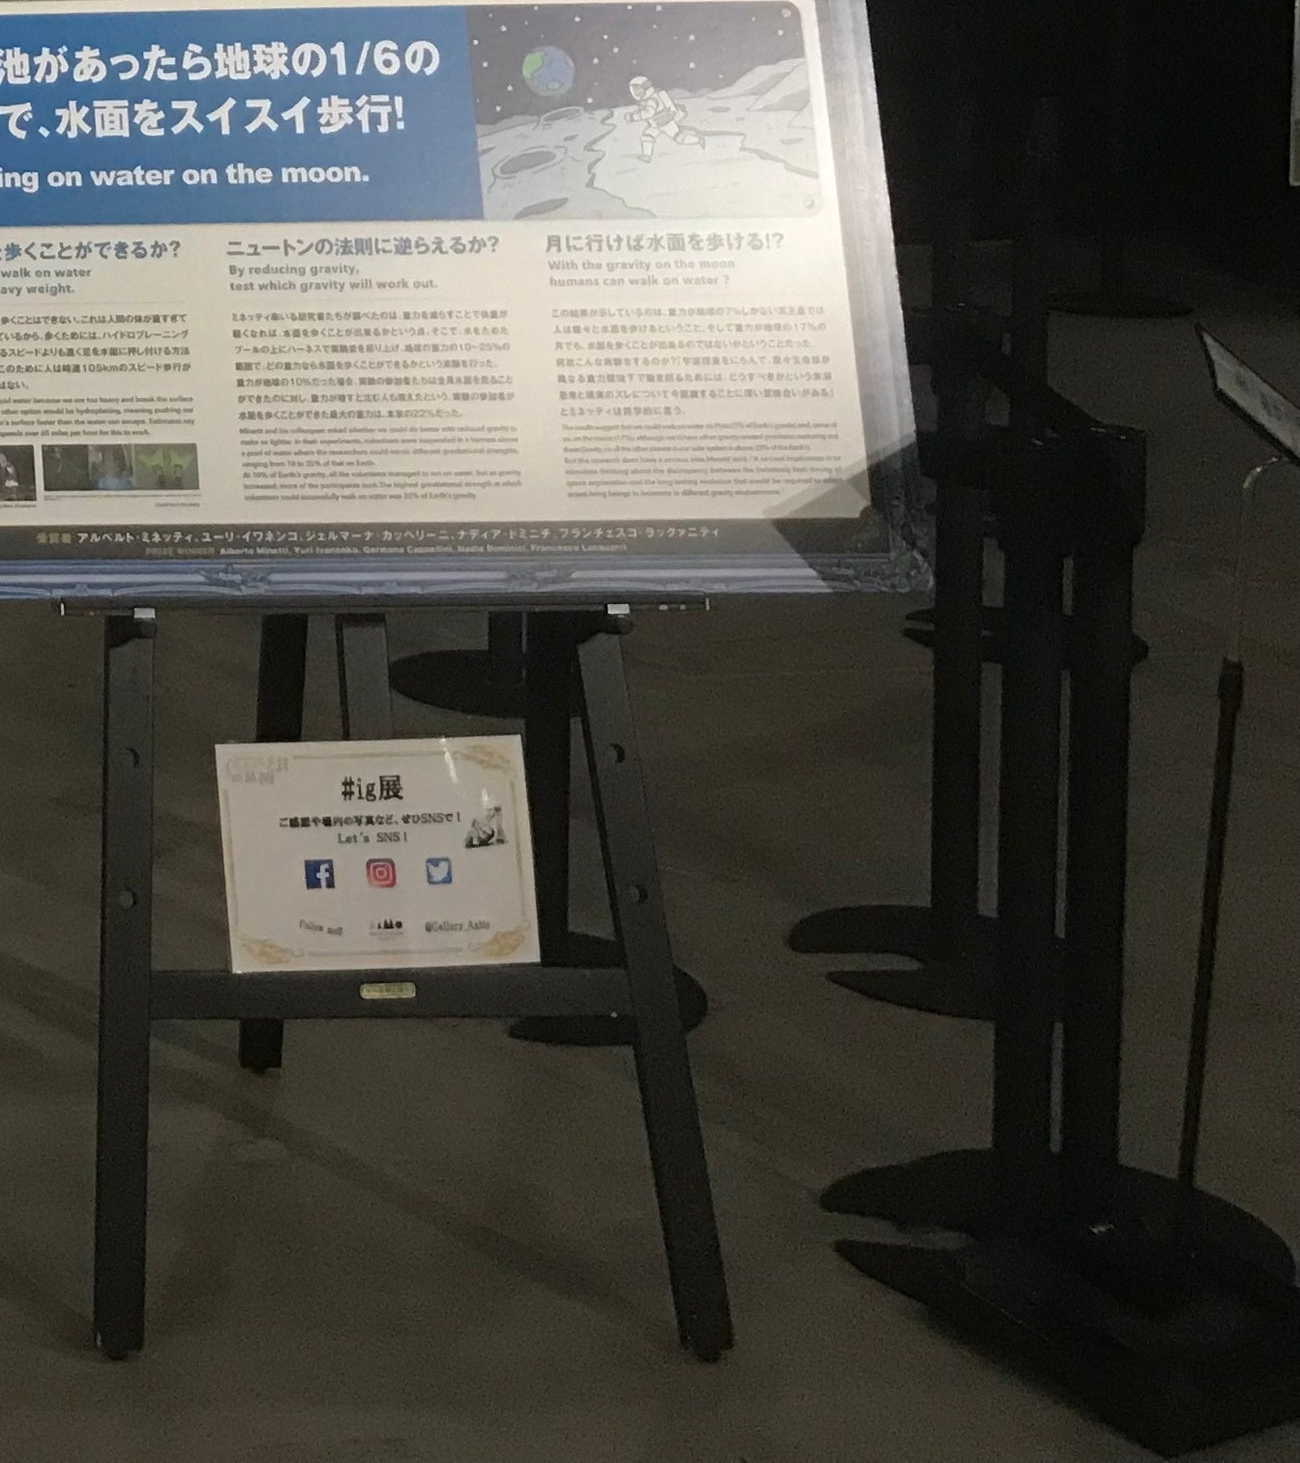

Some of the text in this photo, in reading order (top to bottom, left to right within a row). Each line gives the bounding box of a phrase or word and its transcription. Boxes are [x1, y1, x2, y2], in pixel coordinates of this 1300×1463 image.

[47, 164, 82, 187] on
[90, 164, 176, 187] water
[185, 163, 218, 186] on
[226, 160, 273, 185] the
[282, 160, 369, 185] moon.
[229, 263, 359, 278] By reducing gravity,
[548, 258, 735, 271] With the gravity on the moon
[1, 268, 31, 278] walk
[35, 270, 51, 278] on
[54, 269, 91, 277] water
[230, 279, 438, 293] test which gravity will work out.
[549, 276, 599, 287] humans
[603, 278, 625, 286] can
[629, 275, 659, 286] walk
[663, 277, 679, 286] on
[682, 276, 718, 285] water
[26, 283, 75, 296] weight.
[342, 775, 403, 802] #ig展
